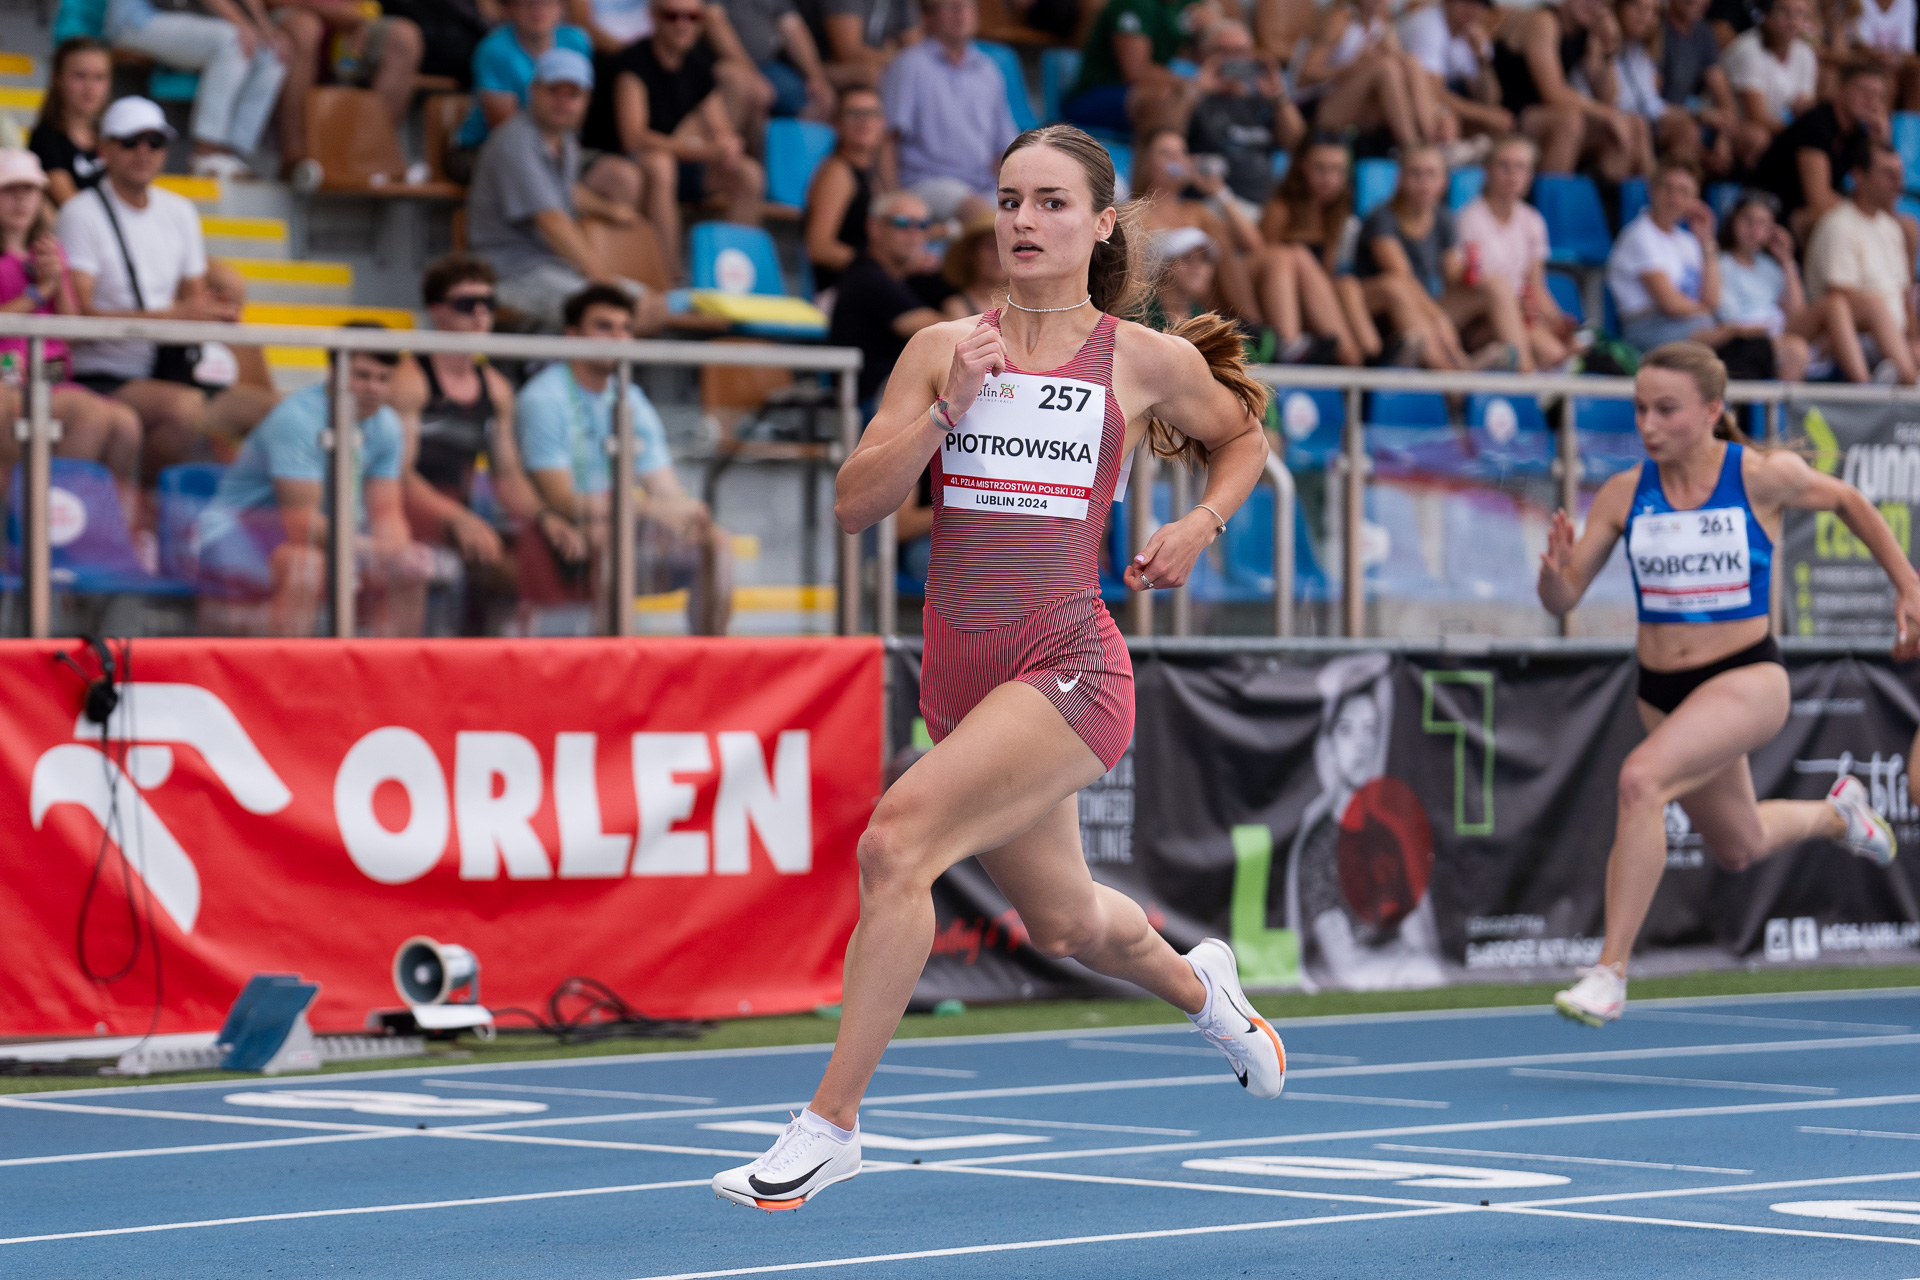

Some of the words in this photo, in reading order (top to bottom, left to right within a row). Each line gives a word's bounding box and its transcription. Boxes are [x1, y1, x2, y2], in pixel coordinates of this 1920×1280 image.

[1038, 384, 1092, 412] 257
[945, 432, 1093, 464] PIOTROWSKA
[950, 477, 960, 486] 41.
[976, 480, 1037, 493] MISTRZOSTWA
[1038, 486, 1069, 495] POLSKI
[1070, 489, 1086, 498] U23
[976, 494, 1015, 507] LUBLIN
[1017, 497, 1048, 509] 2024
[1699, 514, 1735, 536] 261
[1638, 550, 1743, 577] SOBCZYK
[333, 726, 813, 884] ORLEN
